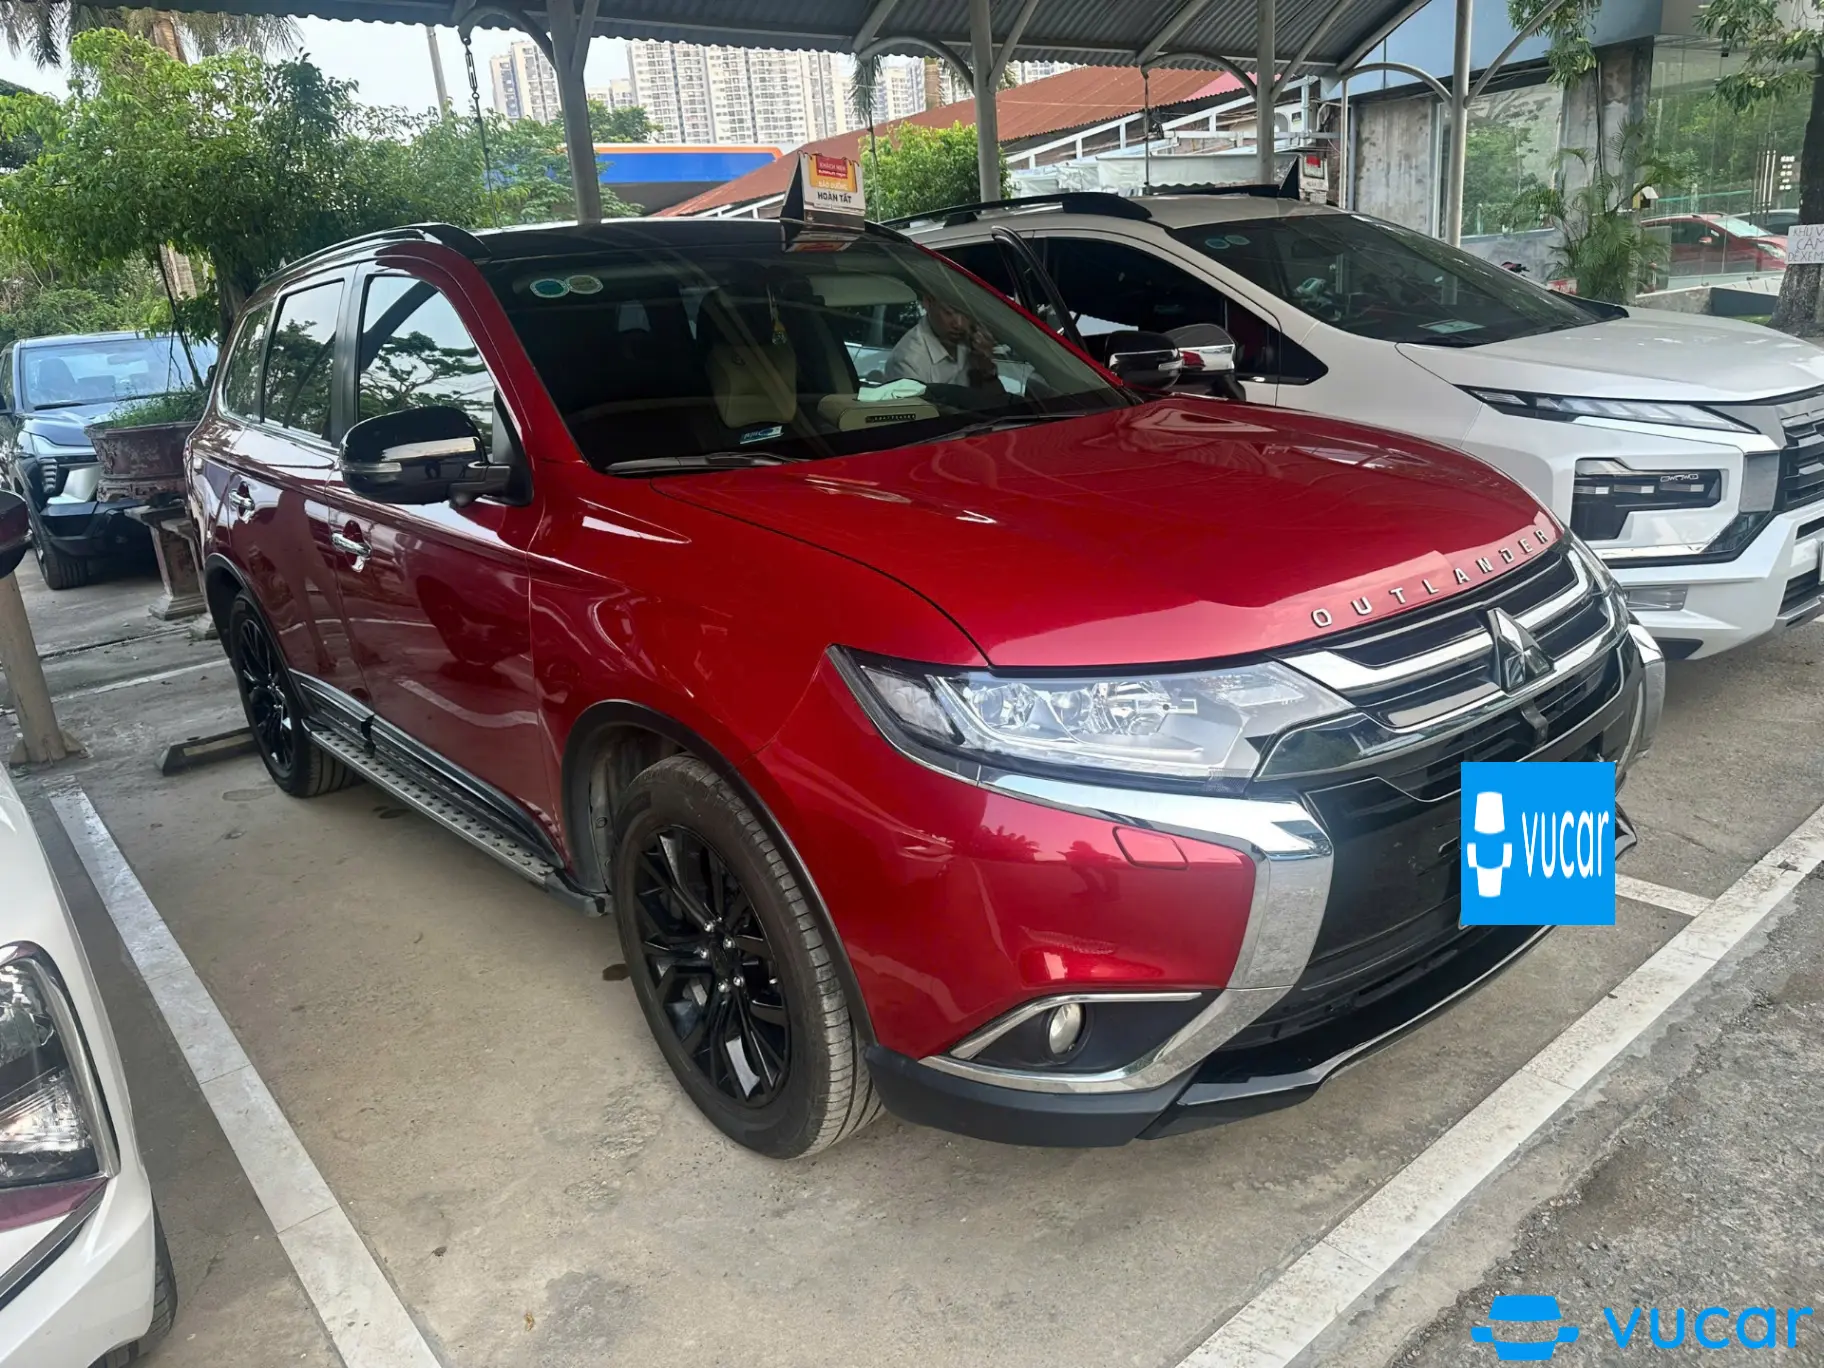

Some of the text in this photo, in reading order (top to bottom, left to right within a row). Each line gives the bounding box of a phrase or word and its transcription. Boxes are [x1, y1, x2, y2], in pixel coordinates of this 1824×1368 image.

[817, 191, 852, 203] HOÀN TẤT
[1311, 528, 1548, 628] OUTLANDER
